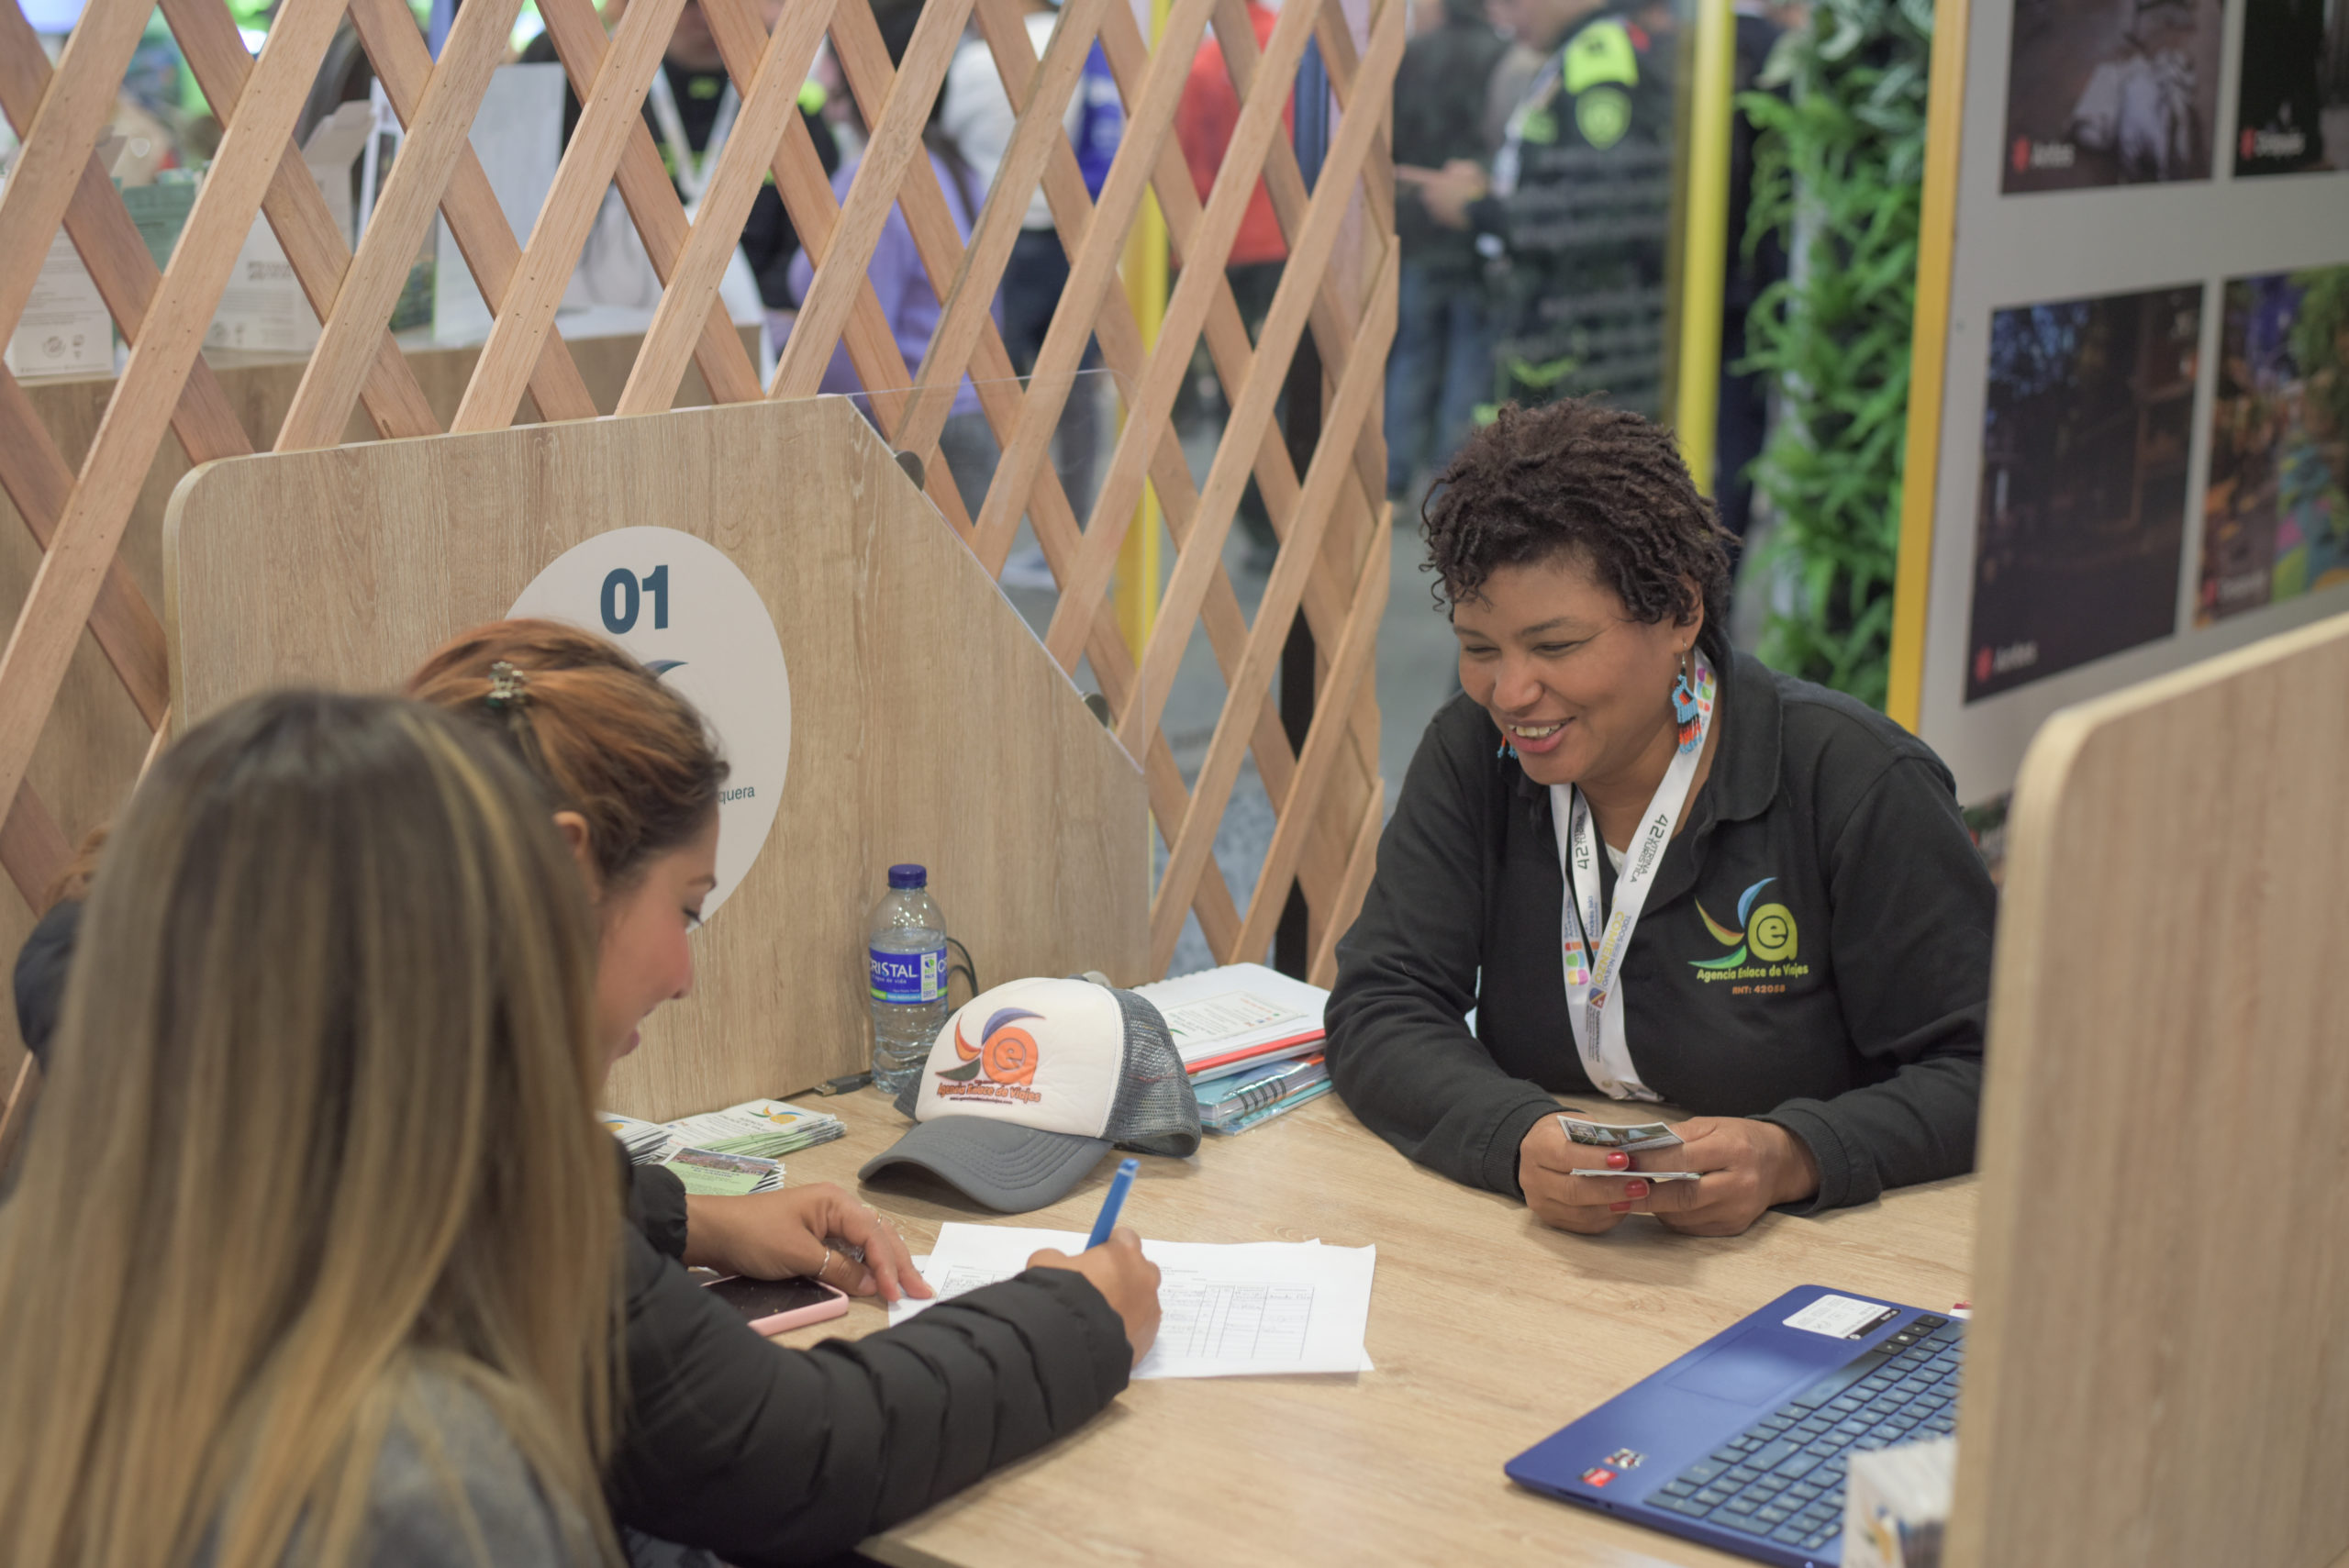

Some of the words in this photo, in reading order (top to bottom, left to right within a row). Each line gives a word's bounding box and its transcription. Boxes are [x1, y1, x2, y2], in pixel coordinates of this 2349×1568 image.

[600, 564, 669, 635] 01
[718, 786, 755, 805] quera
[1648, 813, 1669, 840] 42
[1575, 844, 1590, 871] 42
[1639, 838, 1661, 875] VITRINA
[1594, 911, 1625, 984] COMIENZO
[870, 959, 918, 979] RISTAL
[1697, 968, 1737, 984] Agencia
[1737, 966, 1766, 979] Enlace
[1768, 964, 1782, 977] de
[1783, 962, 1809, 978] Viajes
